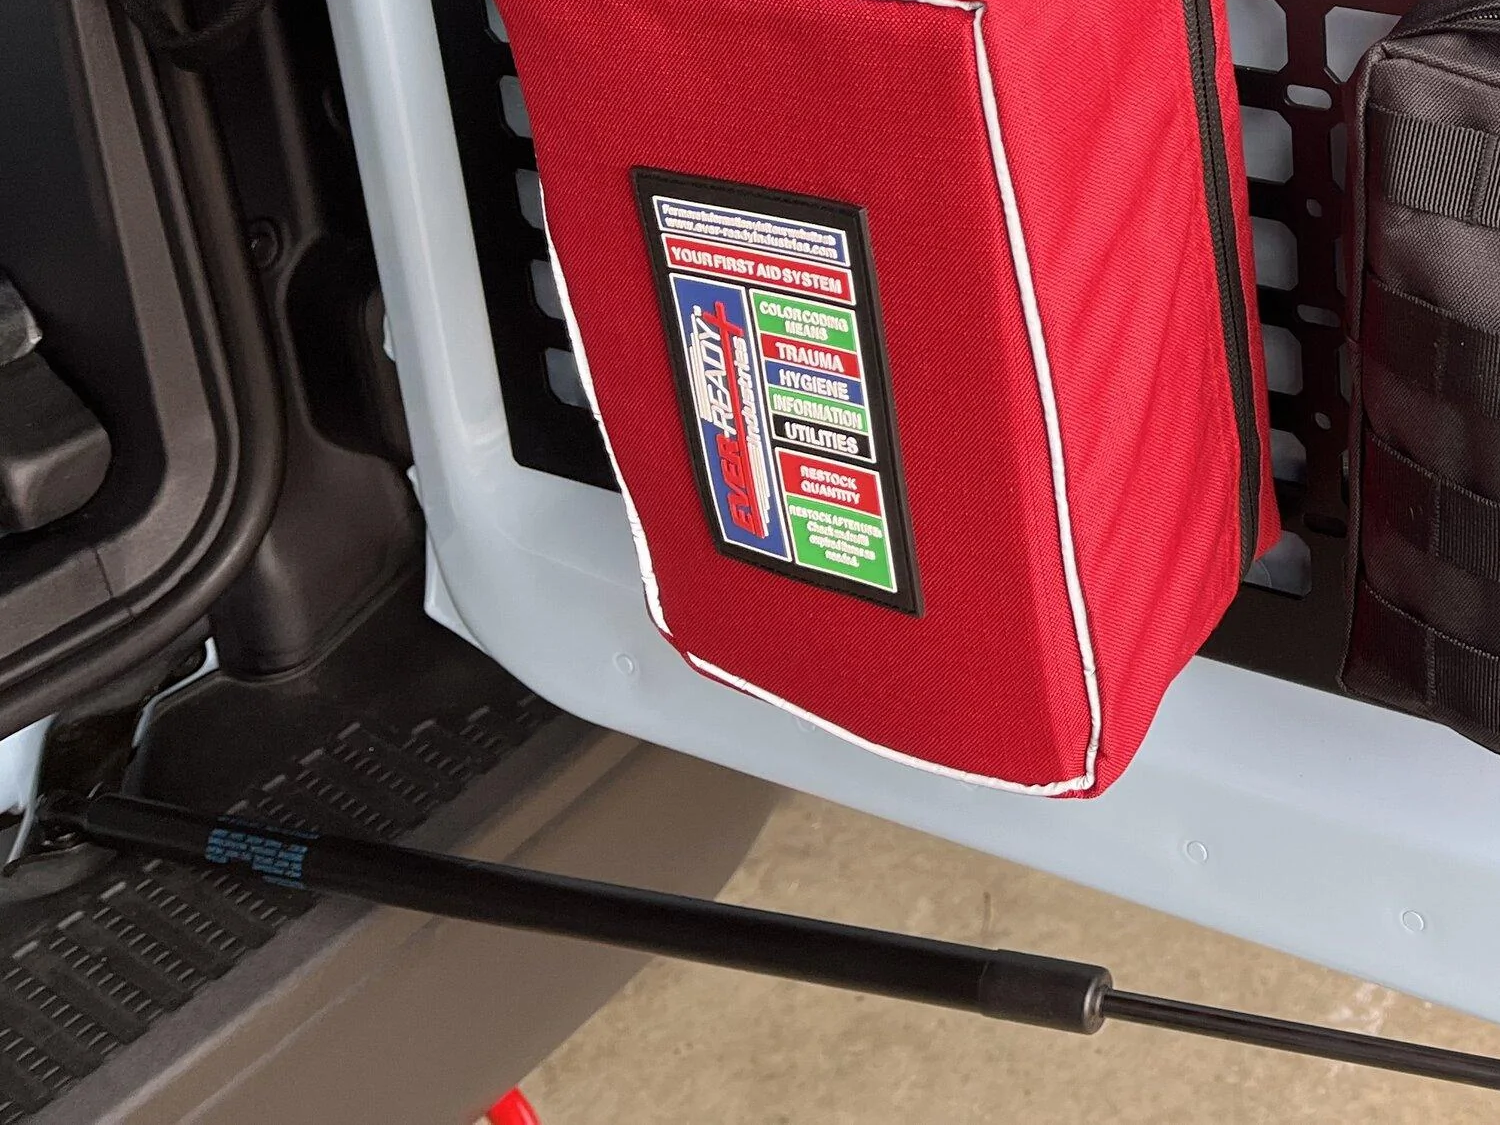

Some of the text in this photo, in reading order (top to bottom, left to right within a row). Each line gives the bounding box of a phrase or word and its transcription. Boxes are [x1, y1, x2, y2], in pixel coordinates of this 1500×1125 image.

[671, 246, 842, 294] YOUR FIRST AID SYSTEM
[759, 300, 849, 333] COLOR CODING
[784, 319, 828, 341] MEANS
[775, 341, 845, 373] TRAUMA
[779, 368, 849, 401] HYGIENE
[772, 393, 863, 431] INFORMATION
[784, 421, 859, 455] UTILITIES
[800, 464, 857, 491] RESTOCK
[800, 479, 860, 505] QUANTITY
